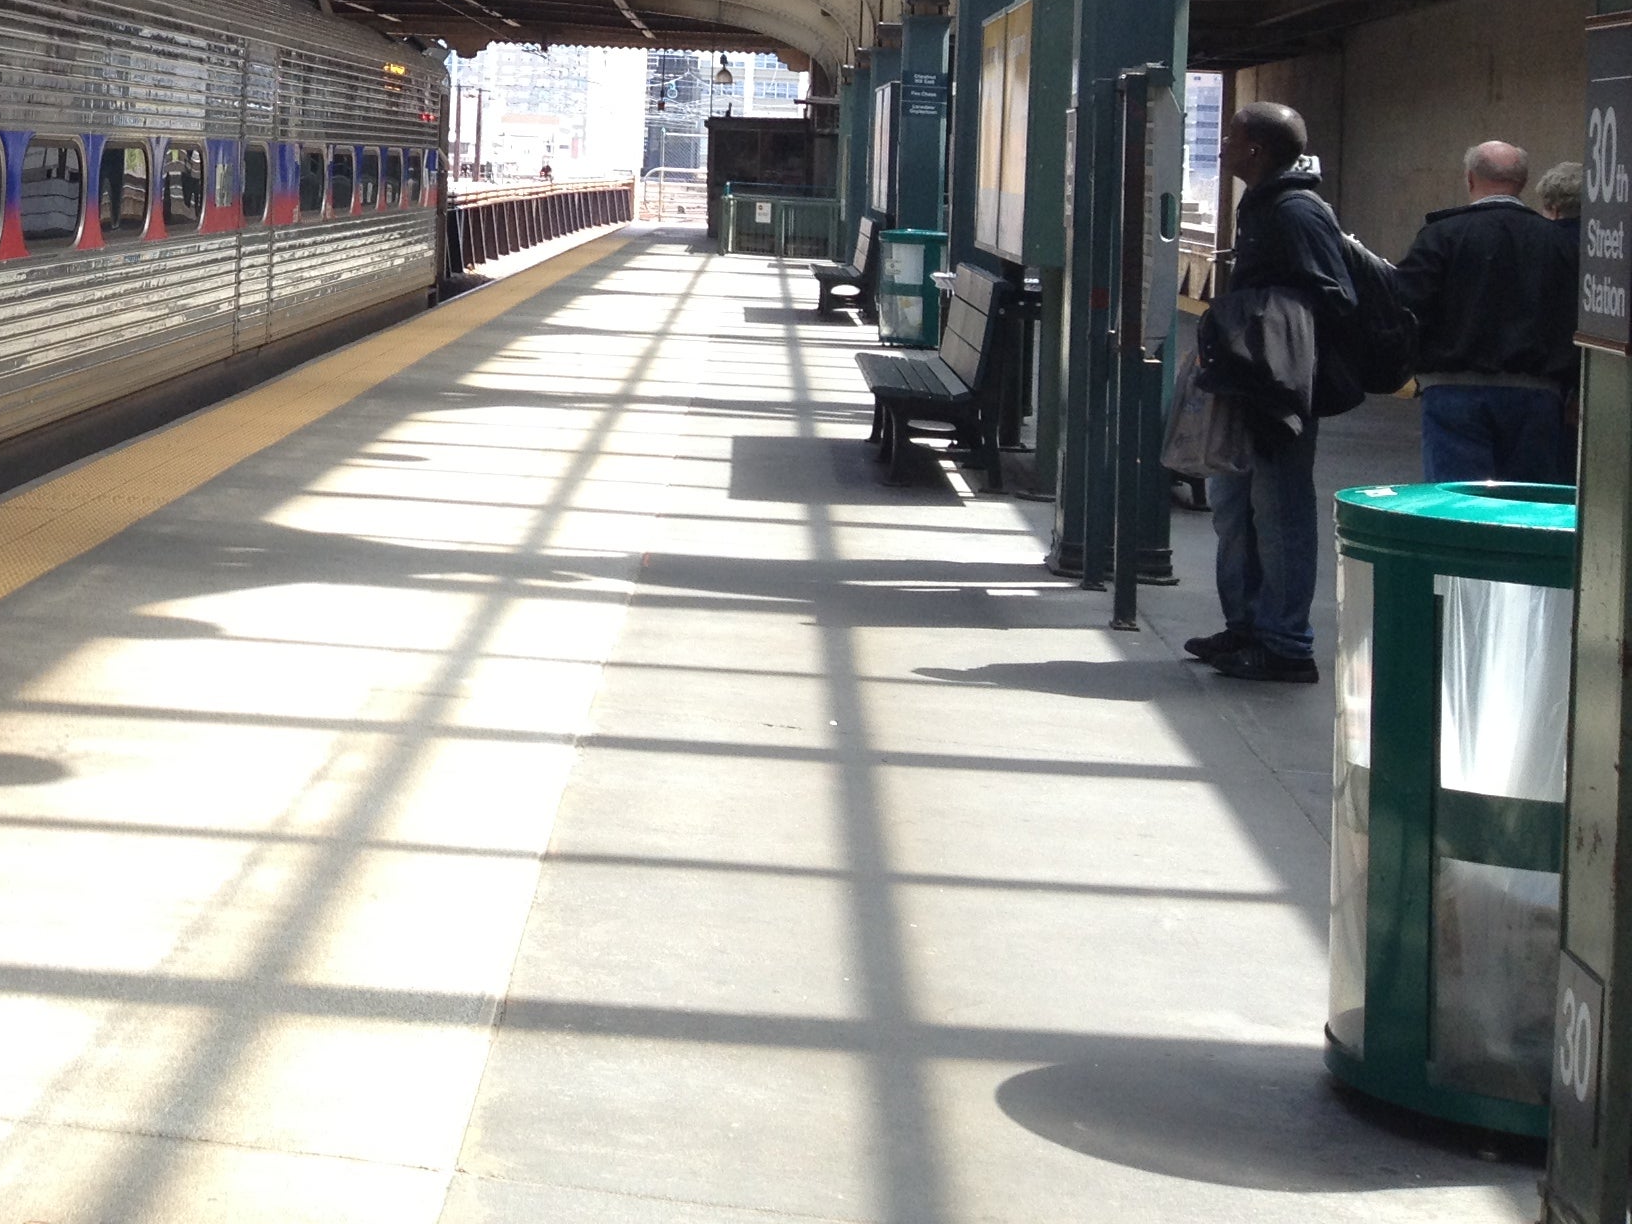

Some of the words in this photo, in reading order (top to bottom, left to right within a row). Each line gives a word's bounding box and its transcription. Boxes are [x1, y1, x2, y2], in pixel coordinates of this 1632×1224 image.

[1587, 106, 1629, 203] 30th
[1587, 218, 1624, 259] Street
[1583, 273, 1626, 317] Station
[1560, 987, 1591, 1103] 30
